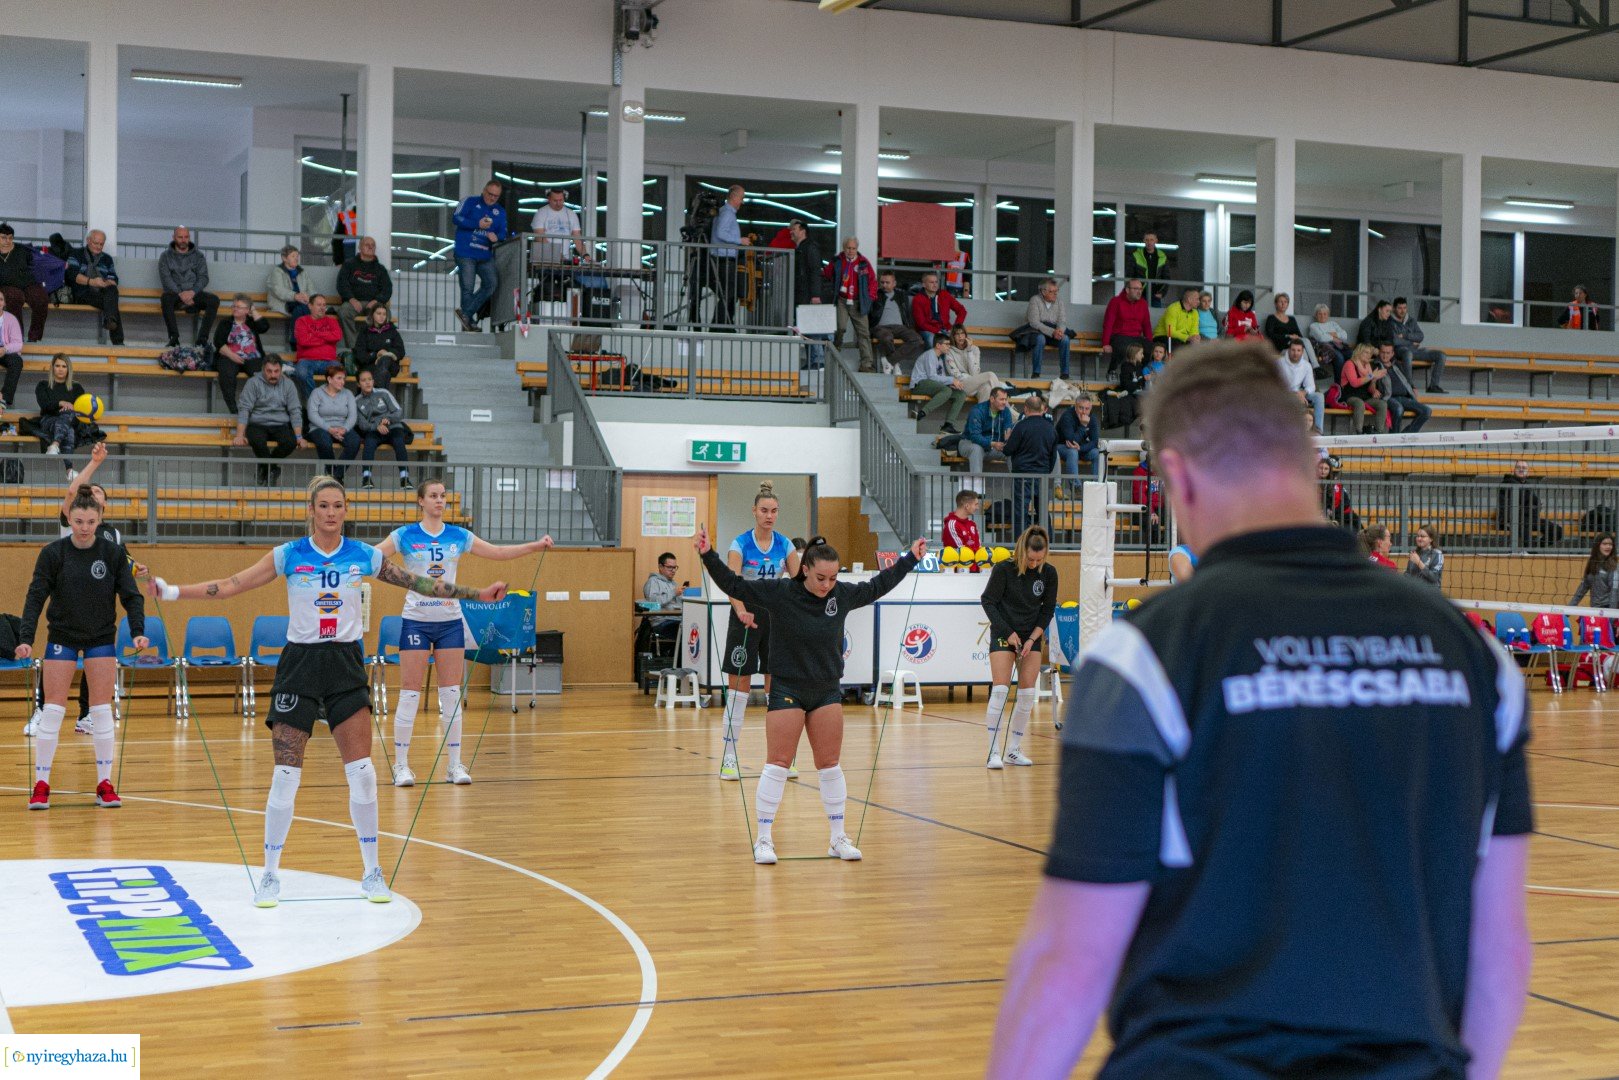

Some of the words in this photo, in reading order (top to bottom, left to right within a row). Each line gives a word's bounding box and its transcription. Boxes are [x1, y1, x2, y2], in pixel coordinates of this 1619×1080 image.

[428, 547, 444, 562] 15
[757, 564, 777, 579] 44
[923, 558, 933, 571] 0
[318, 570, 340, 589] 10
[465, 601, 512, 611] HUNVOLLEY
[407, 634, 421, 646] 15
[53, 643, 63, 655] 9
[1253, 635, 1444, 666] VOLLEYBALL
[1222, 664, 1471, 715] BÉKÉSCSABA
